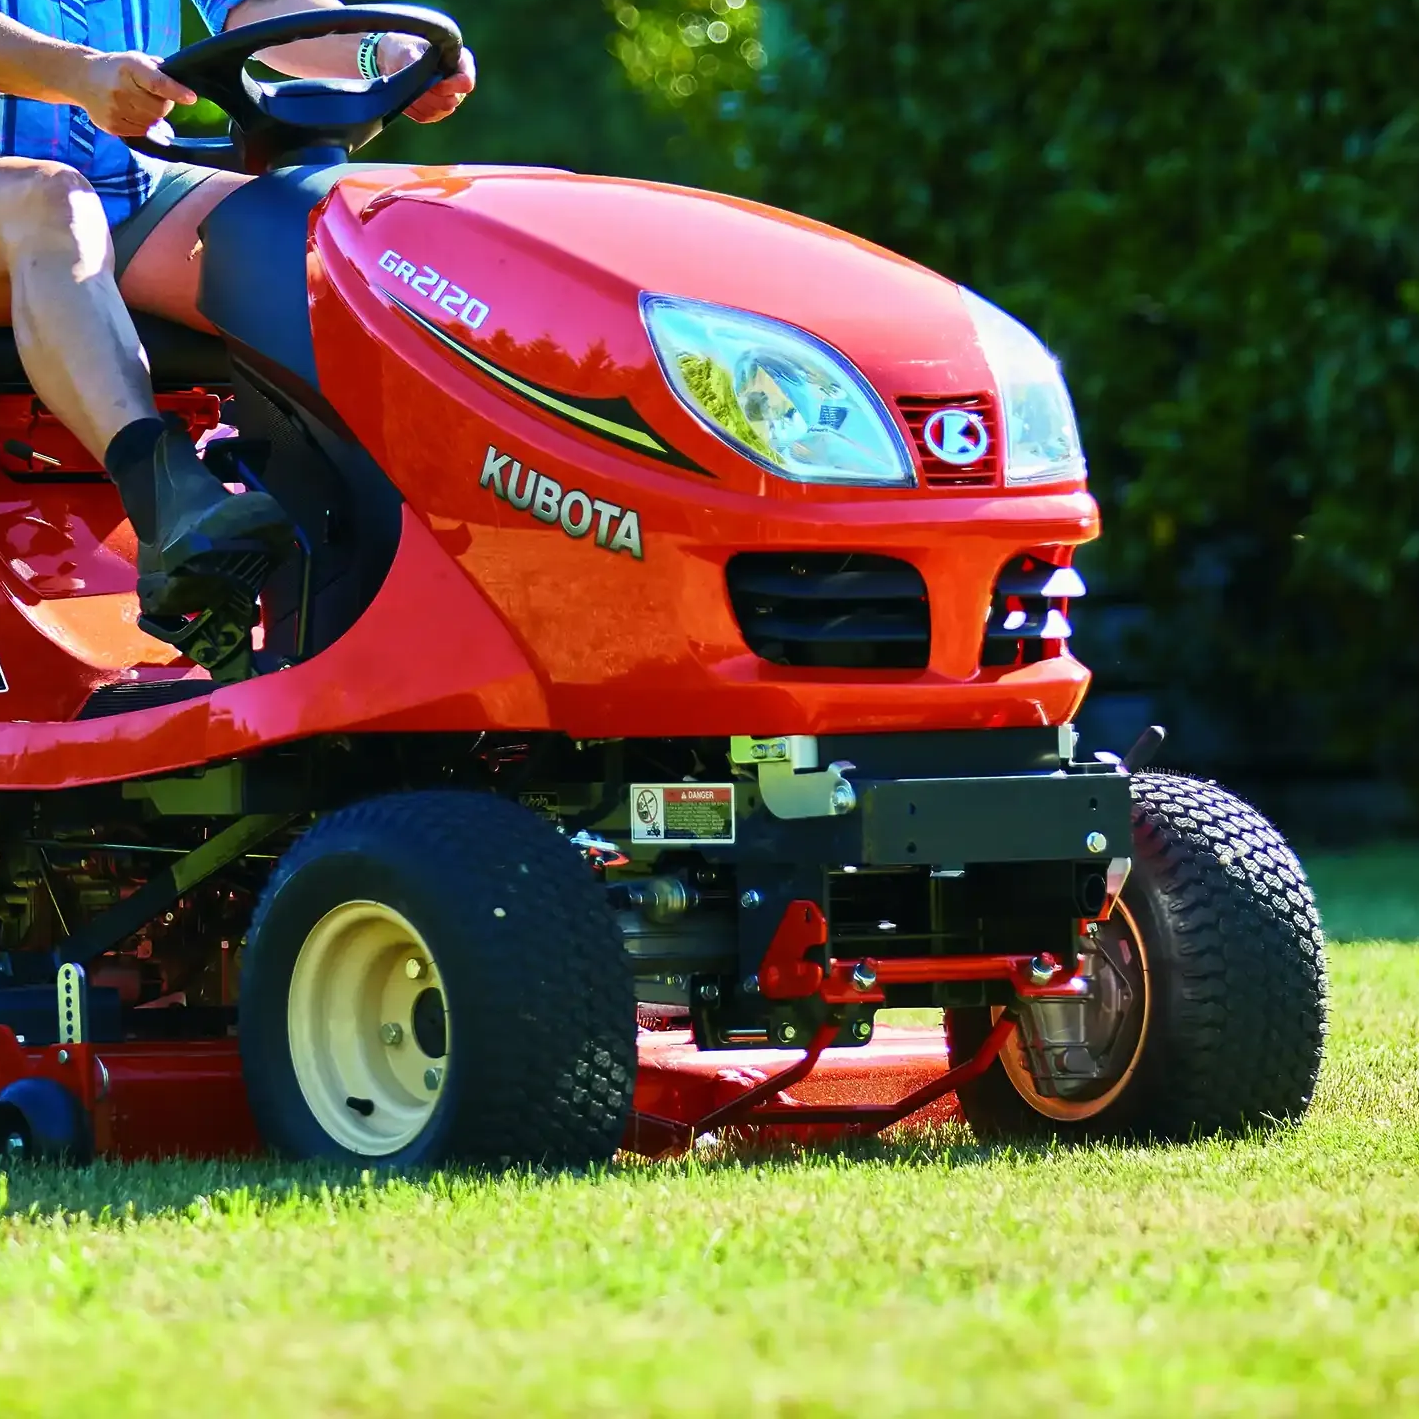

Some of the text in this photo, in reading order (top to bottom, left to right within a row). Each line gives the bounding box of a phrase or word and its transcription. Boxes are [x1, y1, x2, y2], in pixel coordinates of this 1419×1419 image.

[378, 249, 491, 329] GR2120
[480, 445, 643, 560] KUBOTA
[688, 791, 714, 799] DANGER
